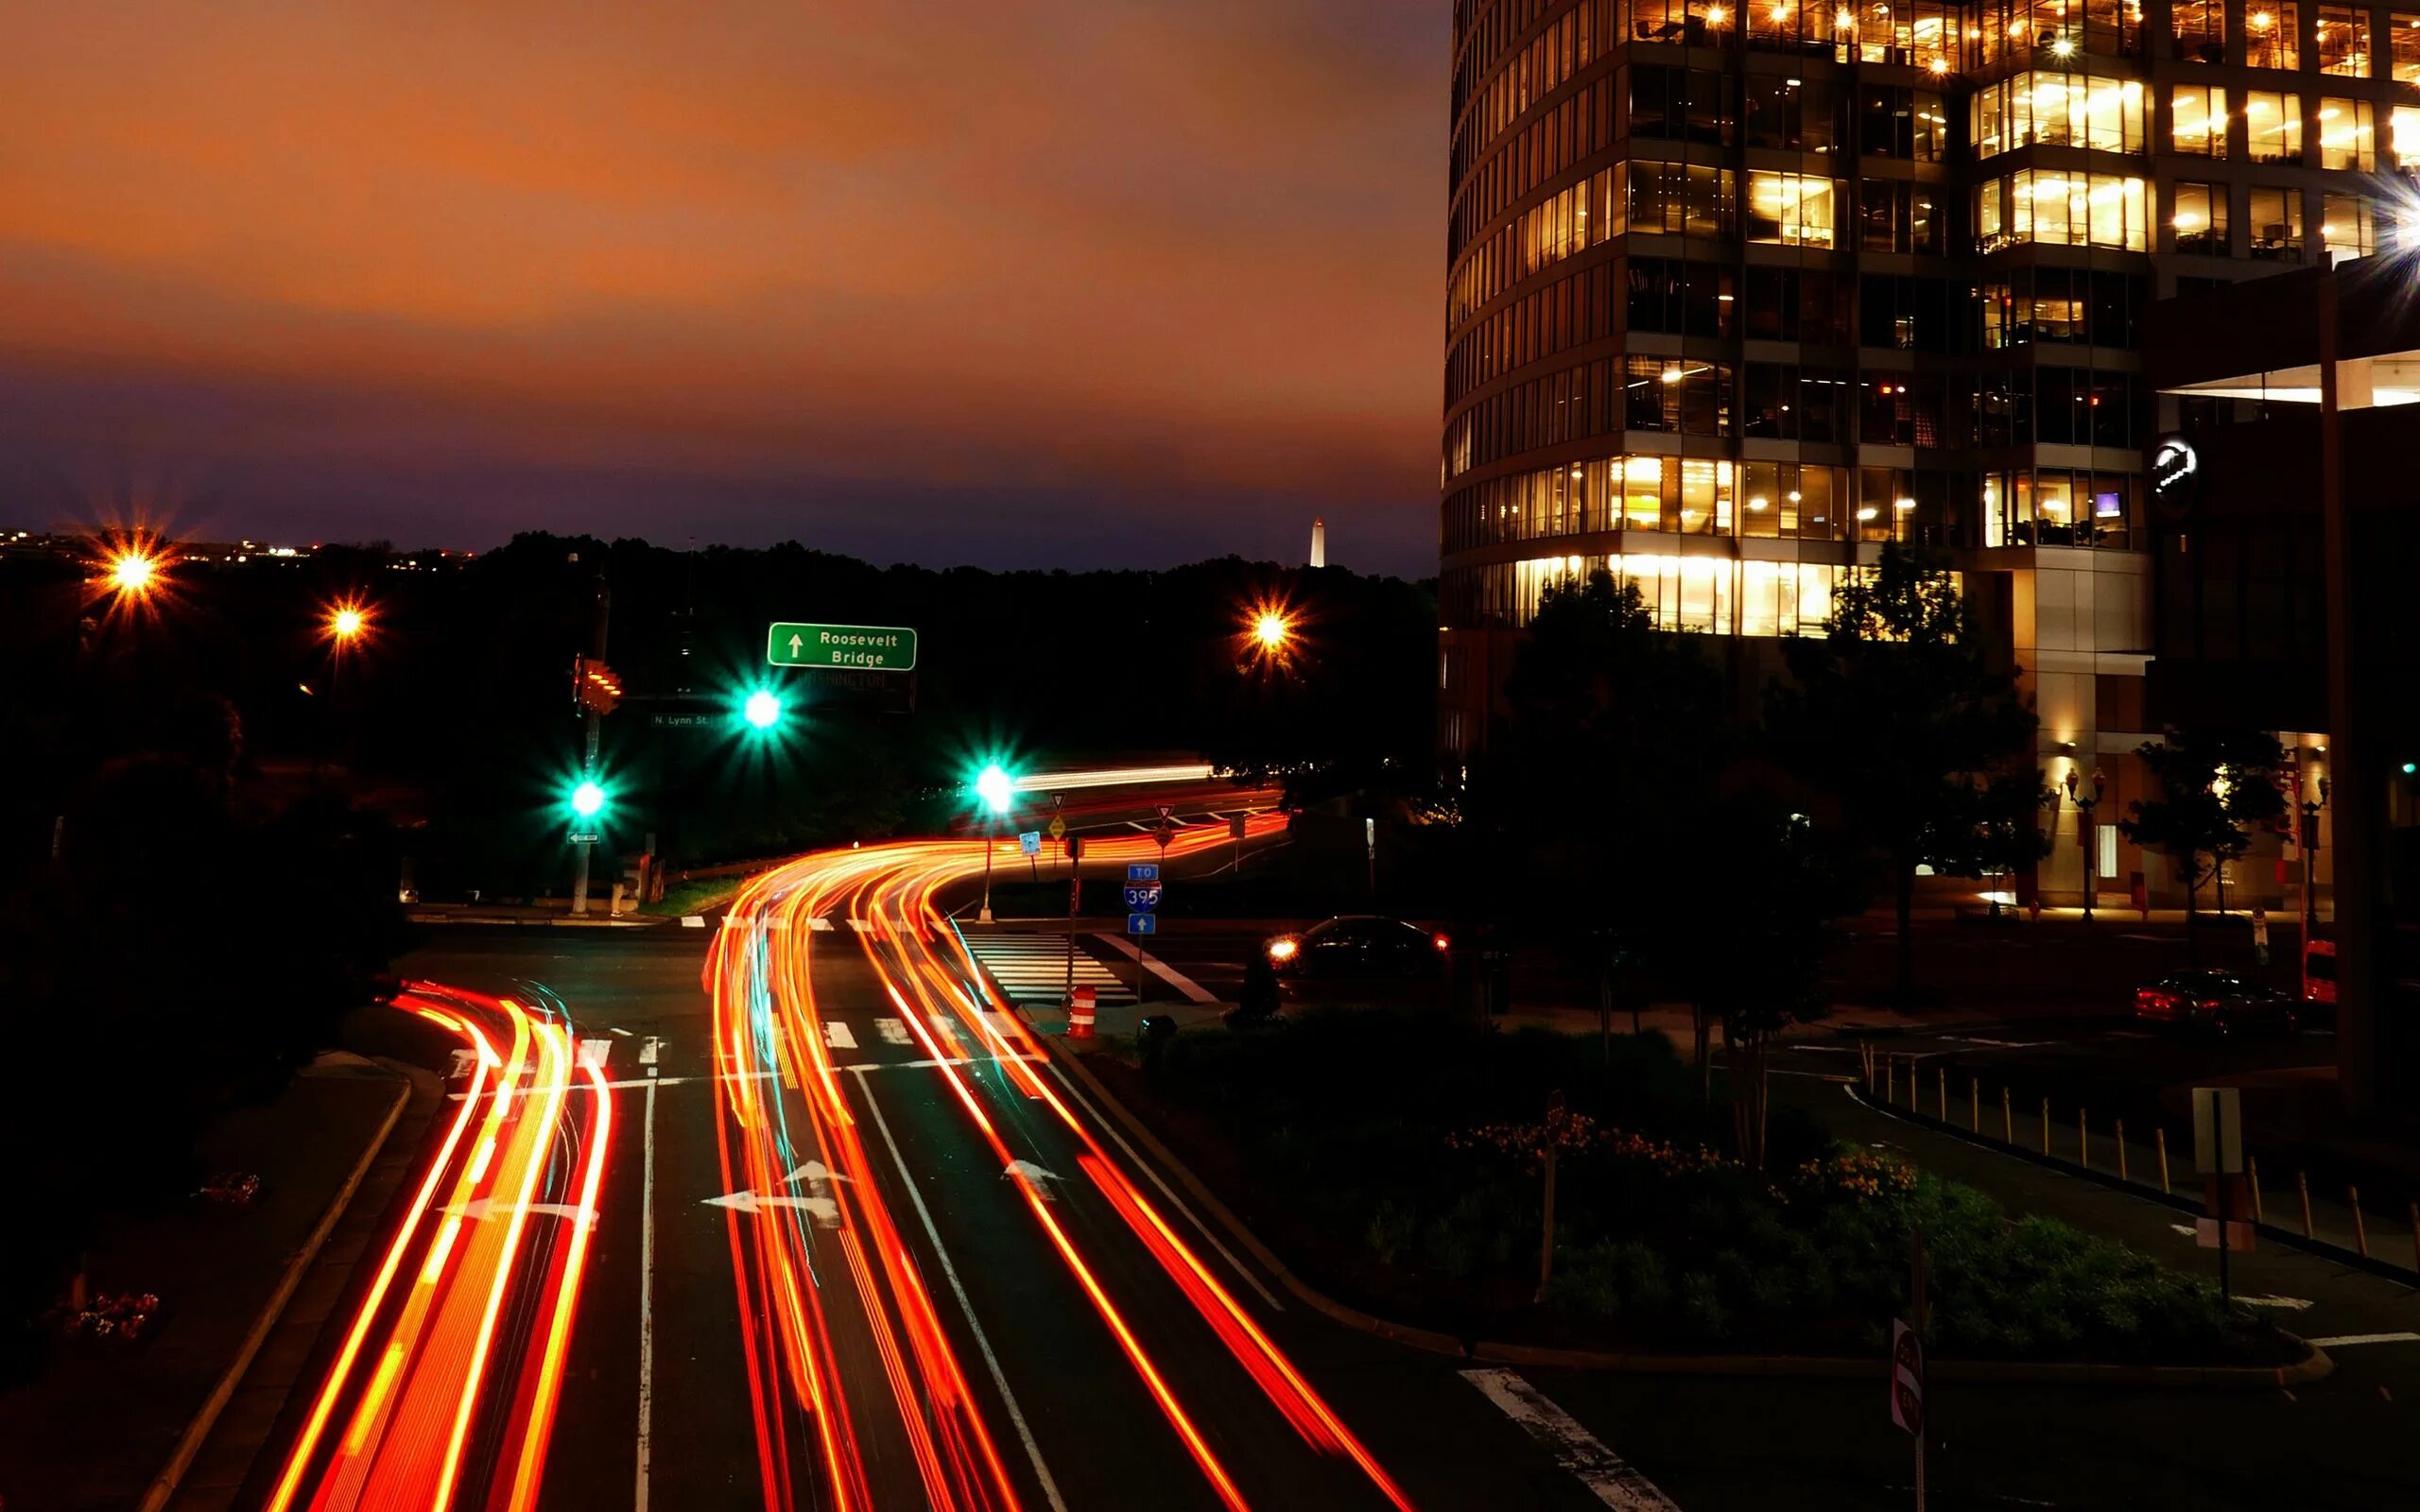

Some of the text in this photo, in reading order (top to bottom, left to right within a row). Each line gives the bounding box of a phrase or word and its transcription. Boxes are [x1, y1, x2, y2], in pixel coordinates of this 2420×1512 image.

[820, 631, 898, 647] Roosevelt
[831, 650, 885, 667] Bridge
[668, 715, 692, 726] Lynn
[1136, 868, 1151, 878] TO
[1128, 890, 1158, 904] 395
